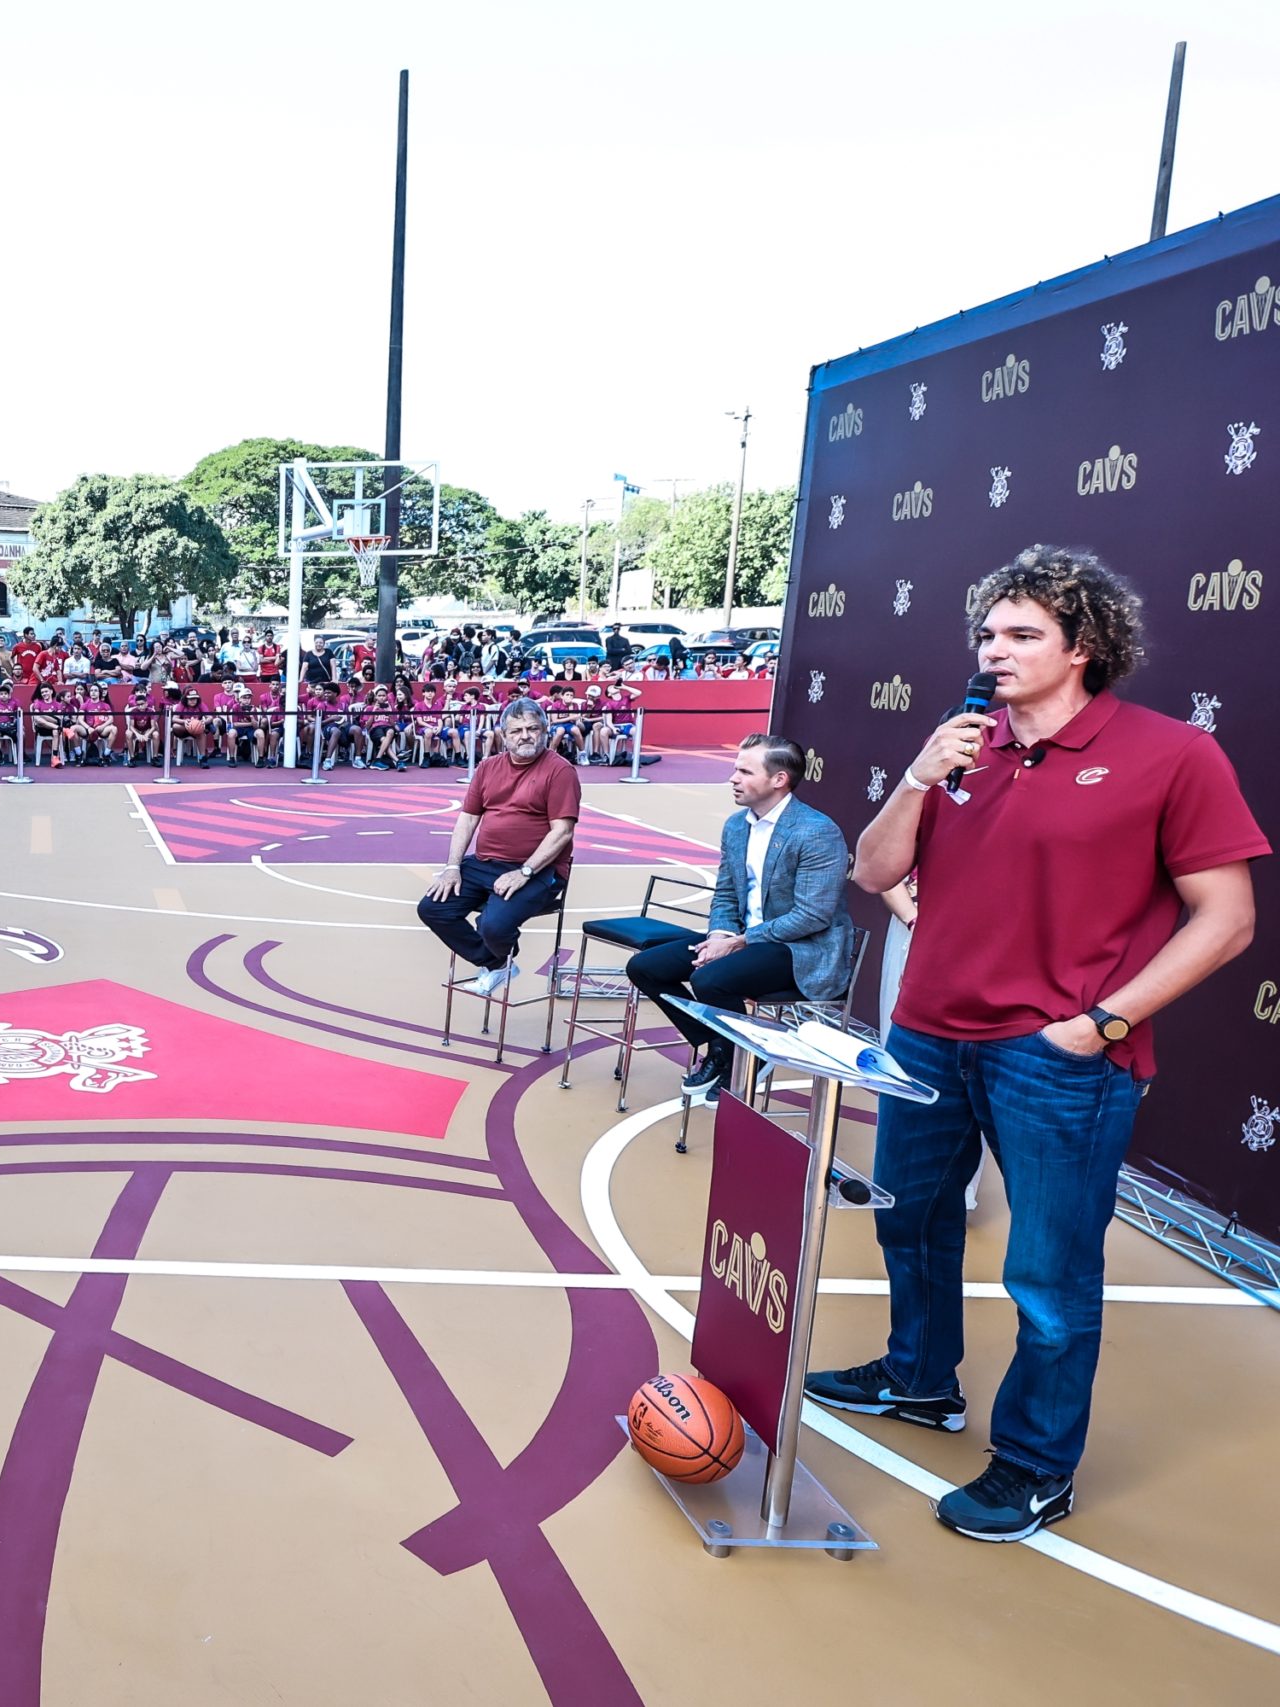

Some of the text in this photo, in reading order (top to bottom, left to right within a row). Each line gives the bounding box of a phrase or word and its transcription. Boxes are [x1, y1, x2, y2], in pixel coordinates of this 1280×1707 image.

[1214, 276, 1280, 341] CAV
[981, 353, 1030, 403] CAVS
[828, 403, 864, 442] CAVS
[1077, 445, 1138, 496] CAVS
[892, 481, 933, 521] CAVS
[808, 583, 846, 617] CAVS
[1187, 559, 1263, 611] CAVS
[870, 674, 912, 711] CAVS
[709, 1218, 788, 1334] CAVS
